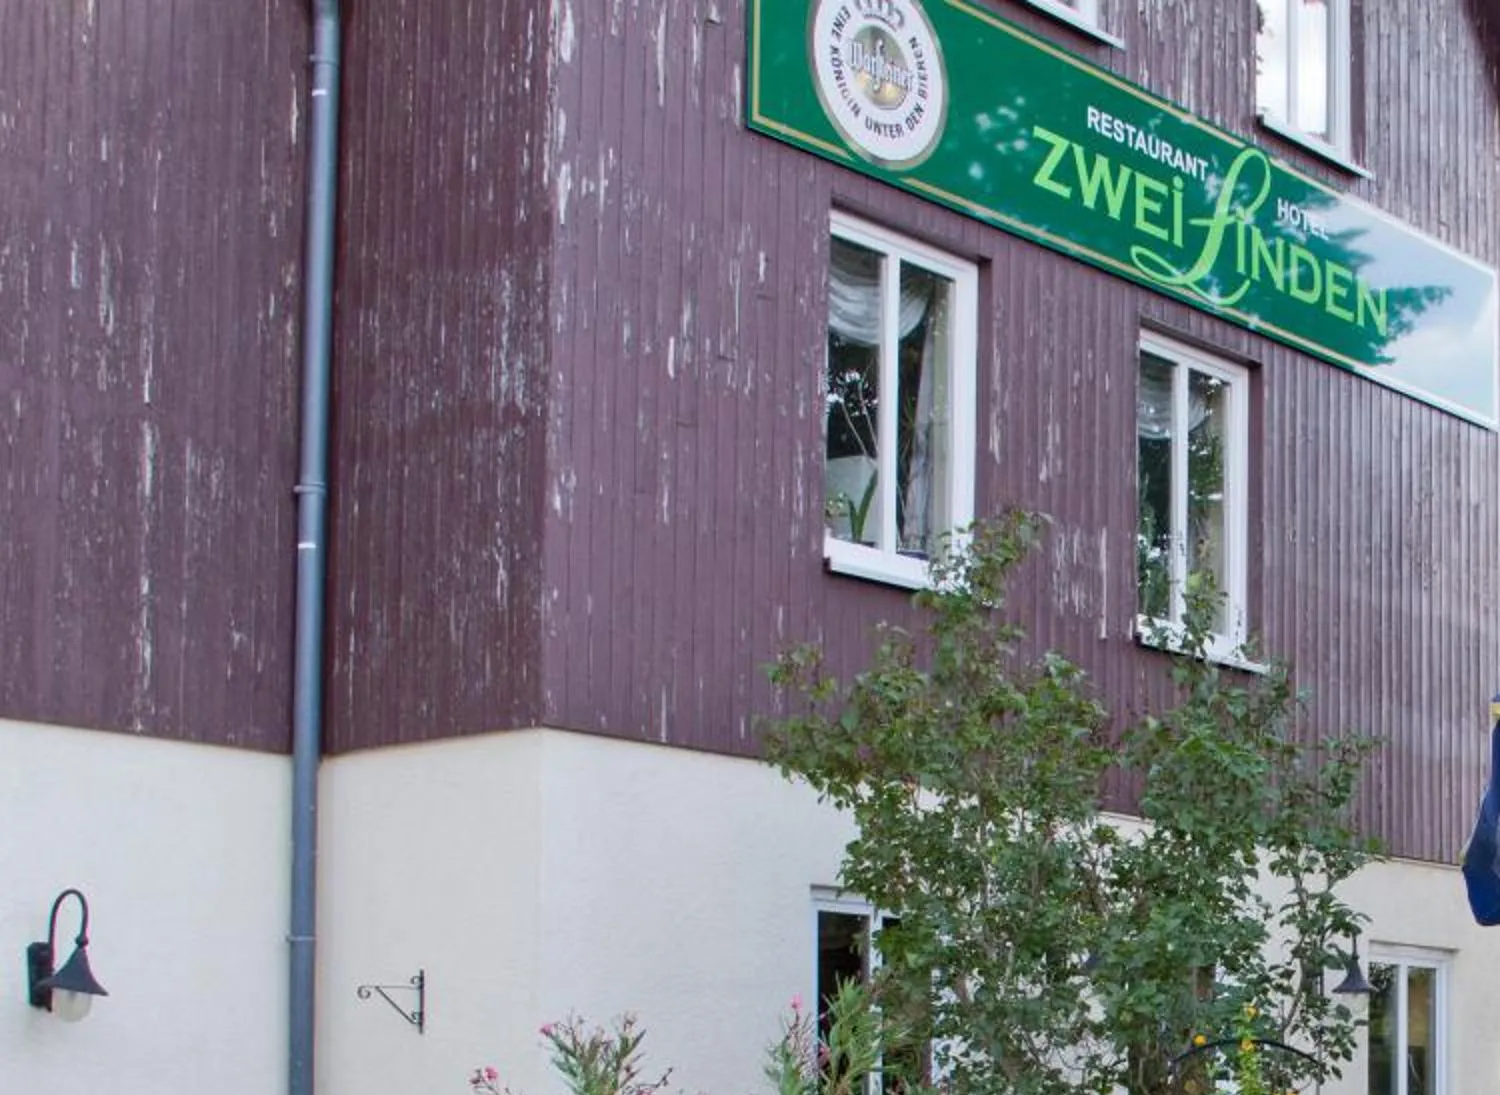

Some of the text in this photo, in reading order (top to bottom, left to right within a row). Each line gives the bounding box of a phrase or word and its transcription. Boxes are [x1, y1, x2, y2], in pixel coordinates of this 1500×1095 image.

[865, 115, 904, 139] UNTER
[905, 102, 925, 131] DEN
[1087, 105, 1209, 182] RESTAURANT
[1276, 197, 1330, 240] HOTEL
